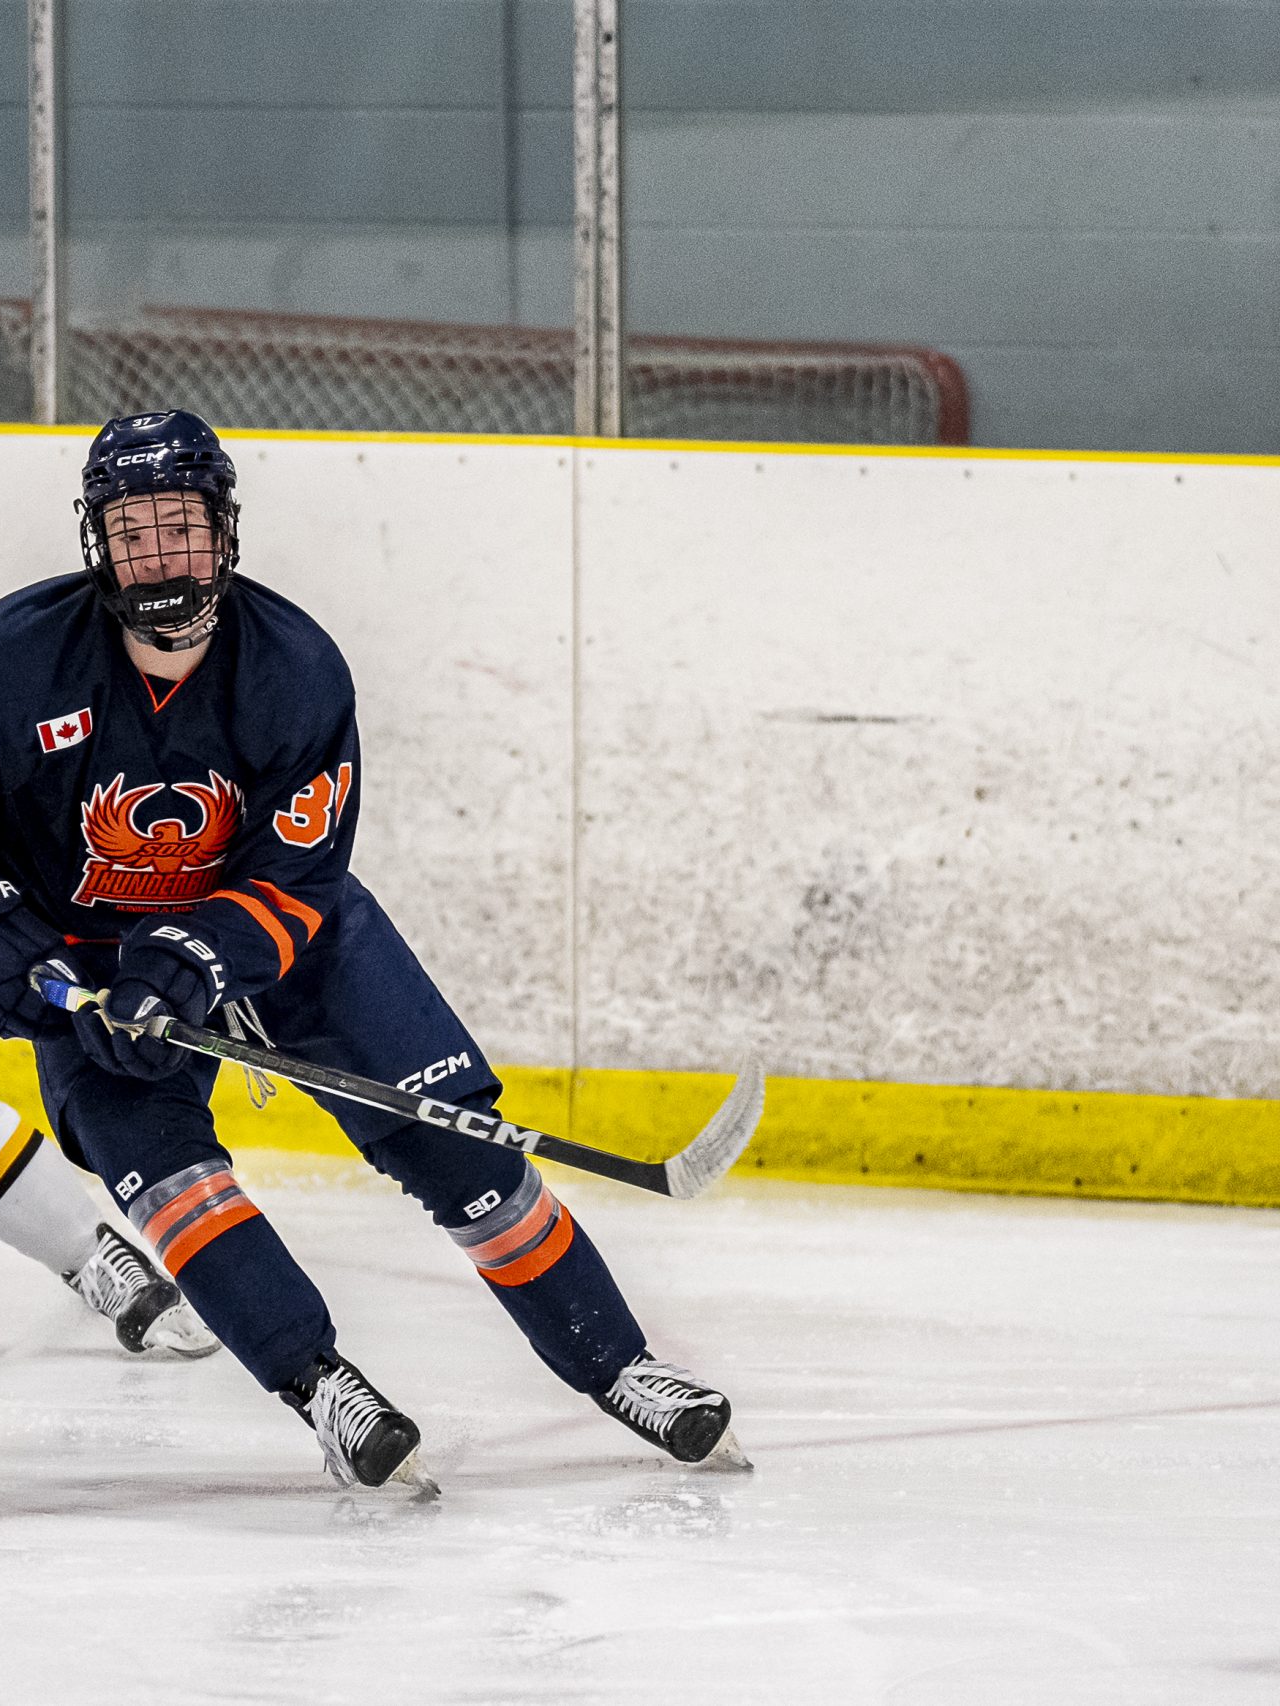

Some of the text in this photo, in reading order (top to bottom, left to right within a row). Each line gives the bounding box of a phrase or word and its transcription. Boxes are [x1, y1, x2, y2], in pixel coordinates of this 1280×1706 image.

[132, 416, 153, 428] 37
[116, 451, 167, 467] CCM
[138, 595, 184, 612] CCM
[140, 842, 197, 857] SOO
[86, 863, 221, 898] THUNDERBI
[149, 925, 226, 1015] BAU
[396, 1051, 472, 1094] CCM
[416, 1098, 543, 1154] CCM
